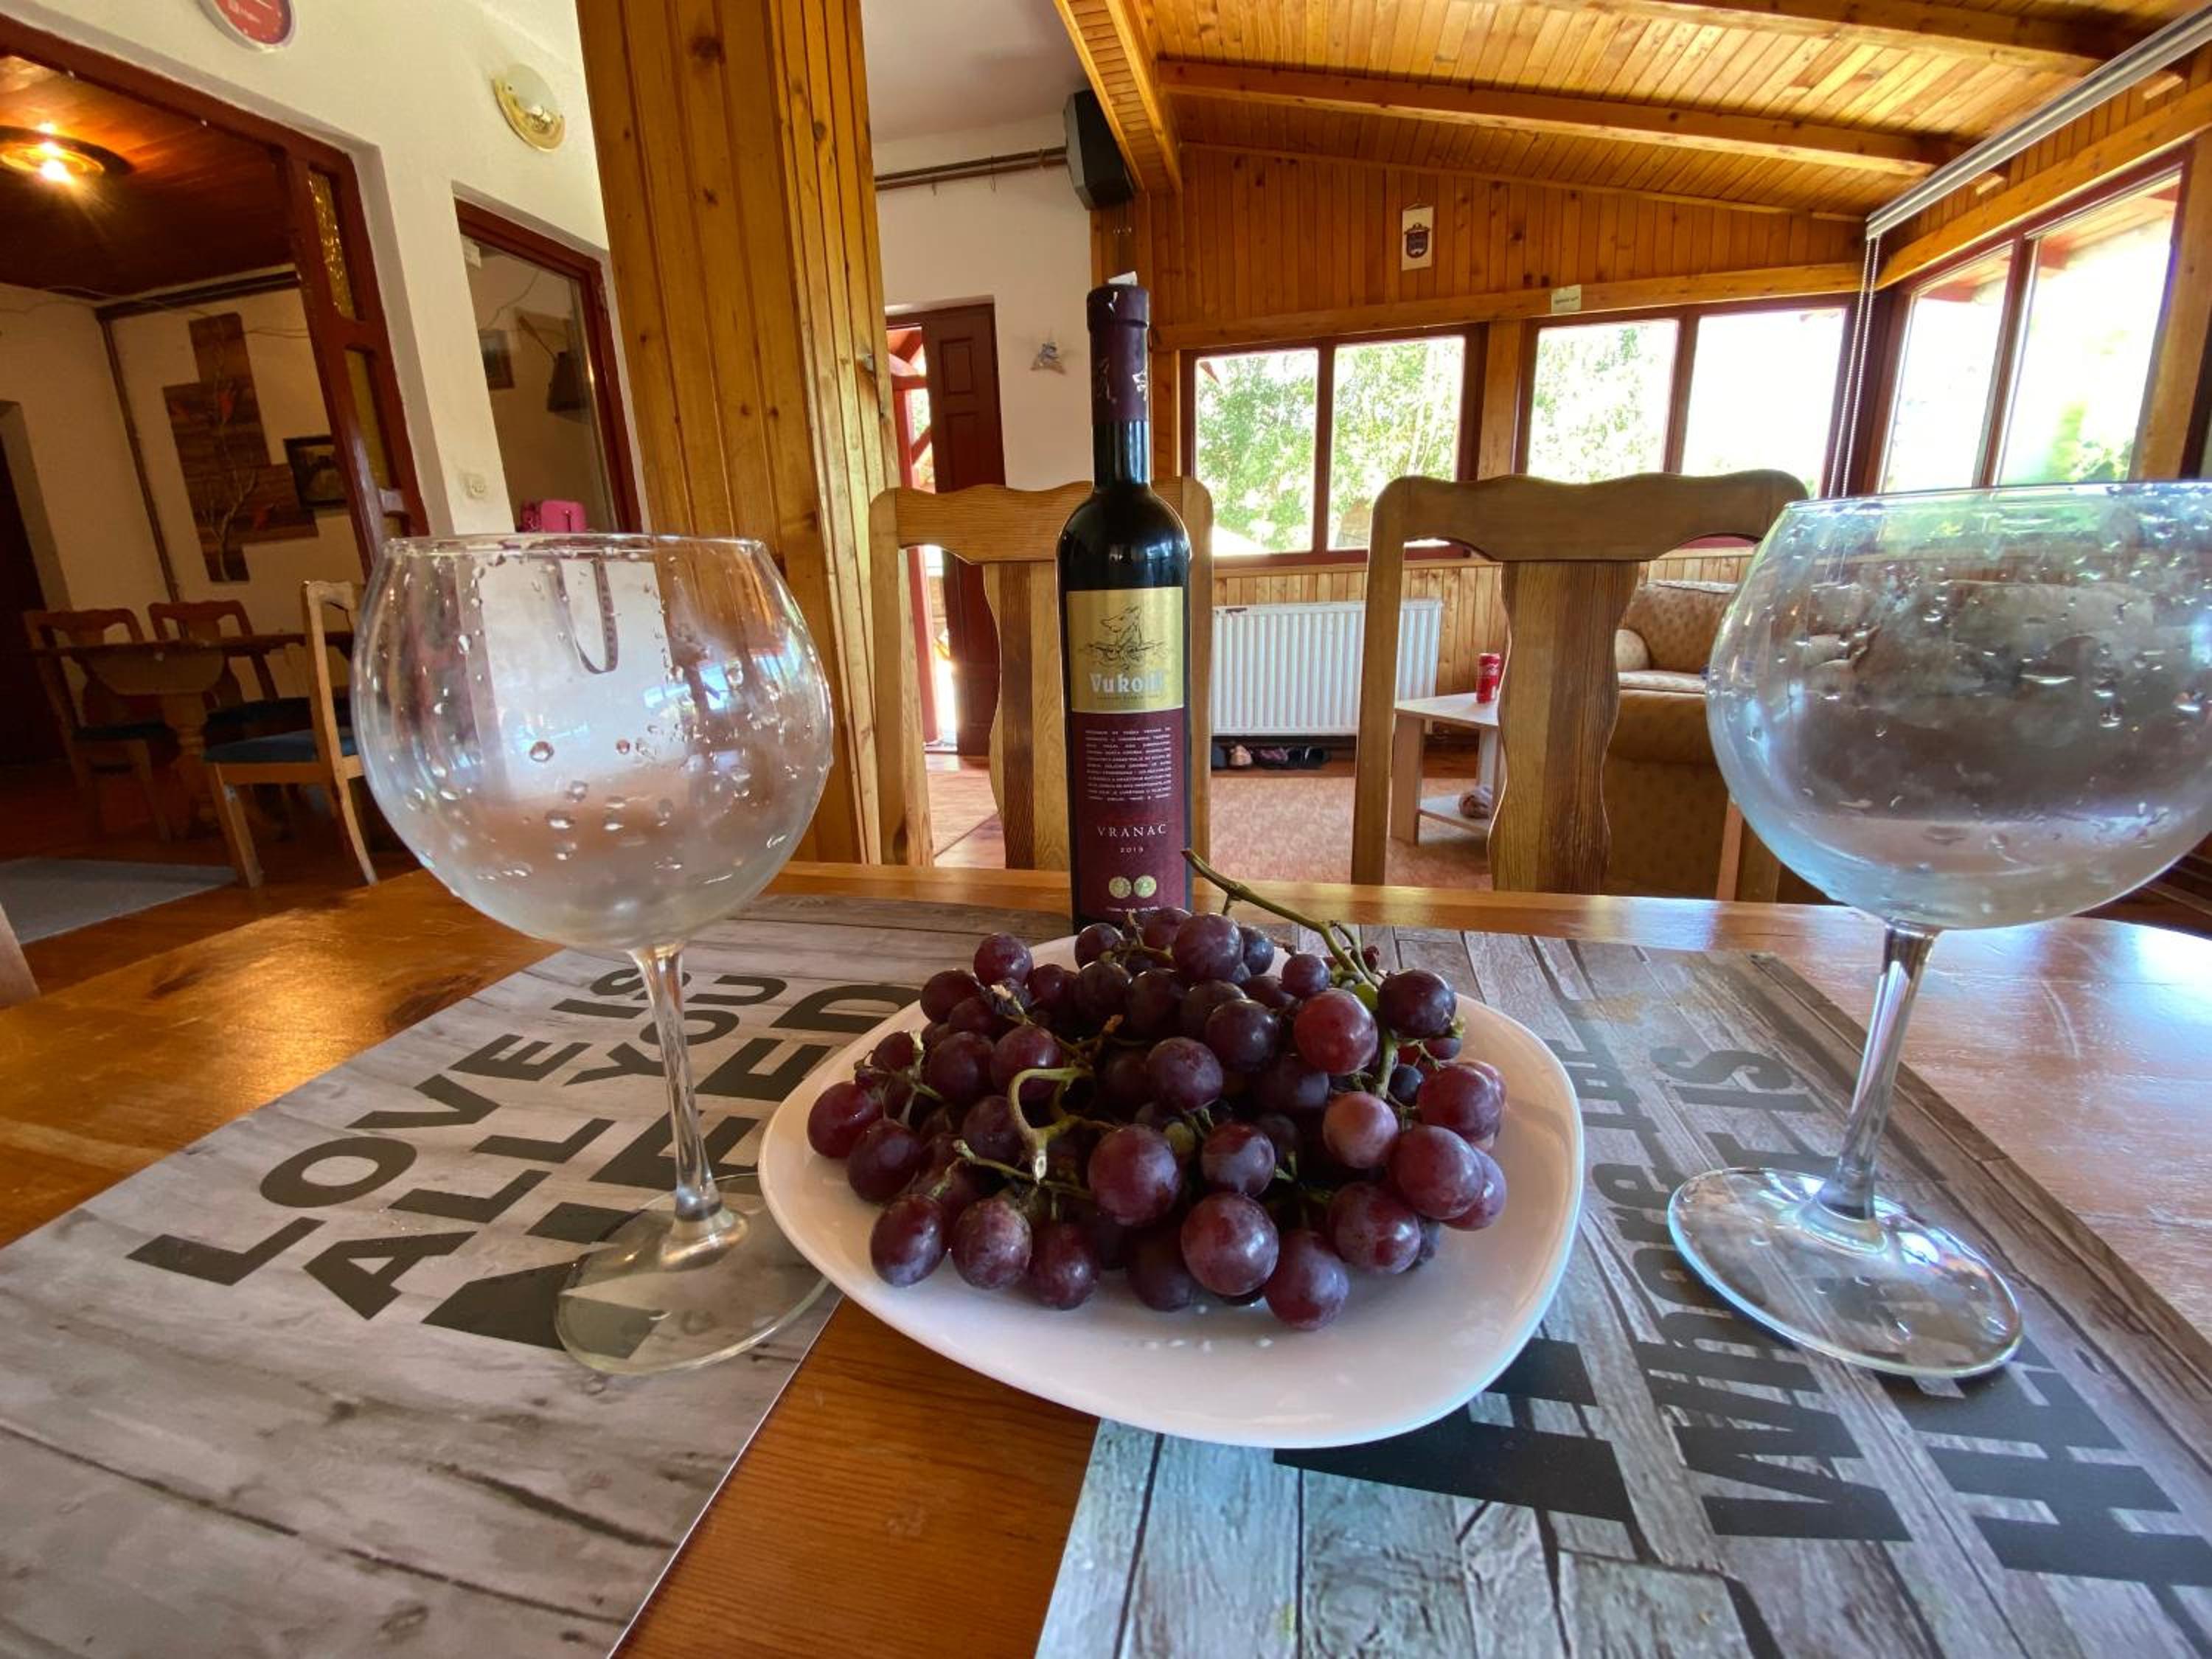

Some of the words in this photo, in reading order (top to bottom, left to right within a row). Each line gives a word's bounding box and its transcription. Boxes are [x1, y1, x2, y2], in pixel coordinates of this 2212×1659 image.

[1097, 824, 1166, 838] VRANAC
[125, 1034, 594, 1286] LOVE
[552, 967, 690, 1020] IS
[302, 1117, 617, 1320] ALL
[564, 974, 787, 1086] YOU
[421, 984, 922, 1360] NEED
[1649, 1046, 1823, 1113] IS
